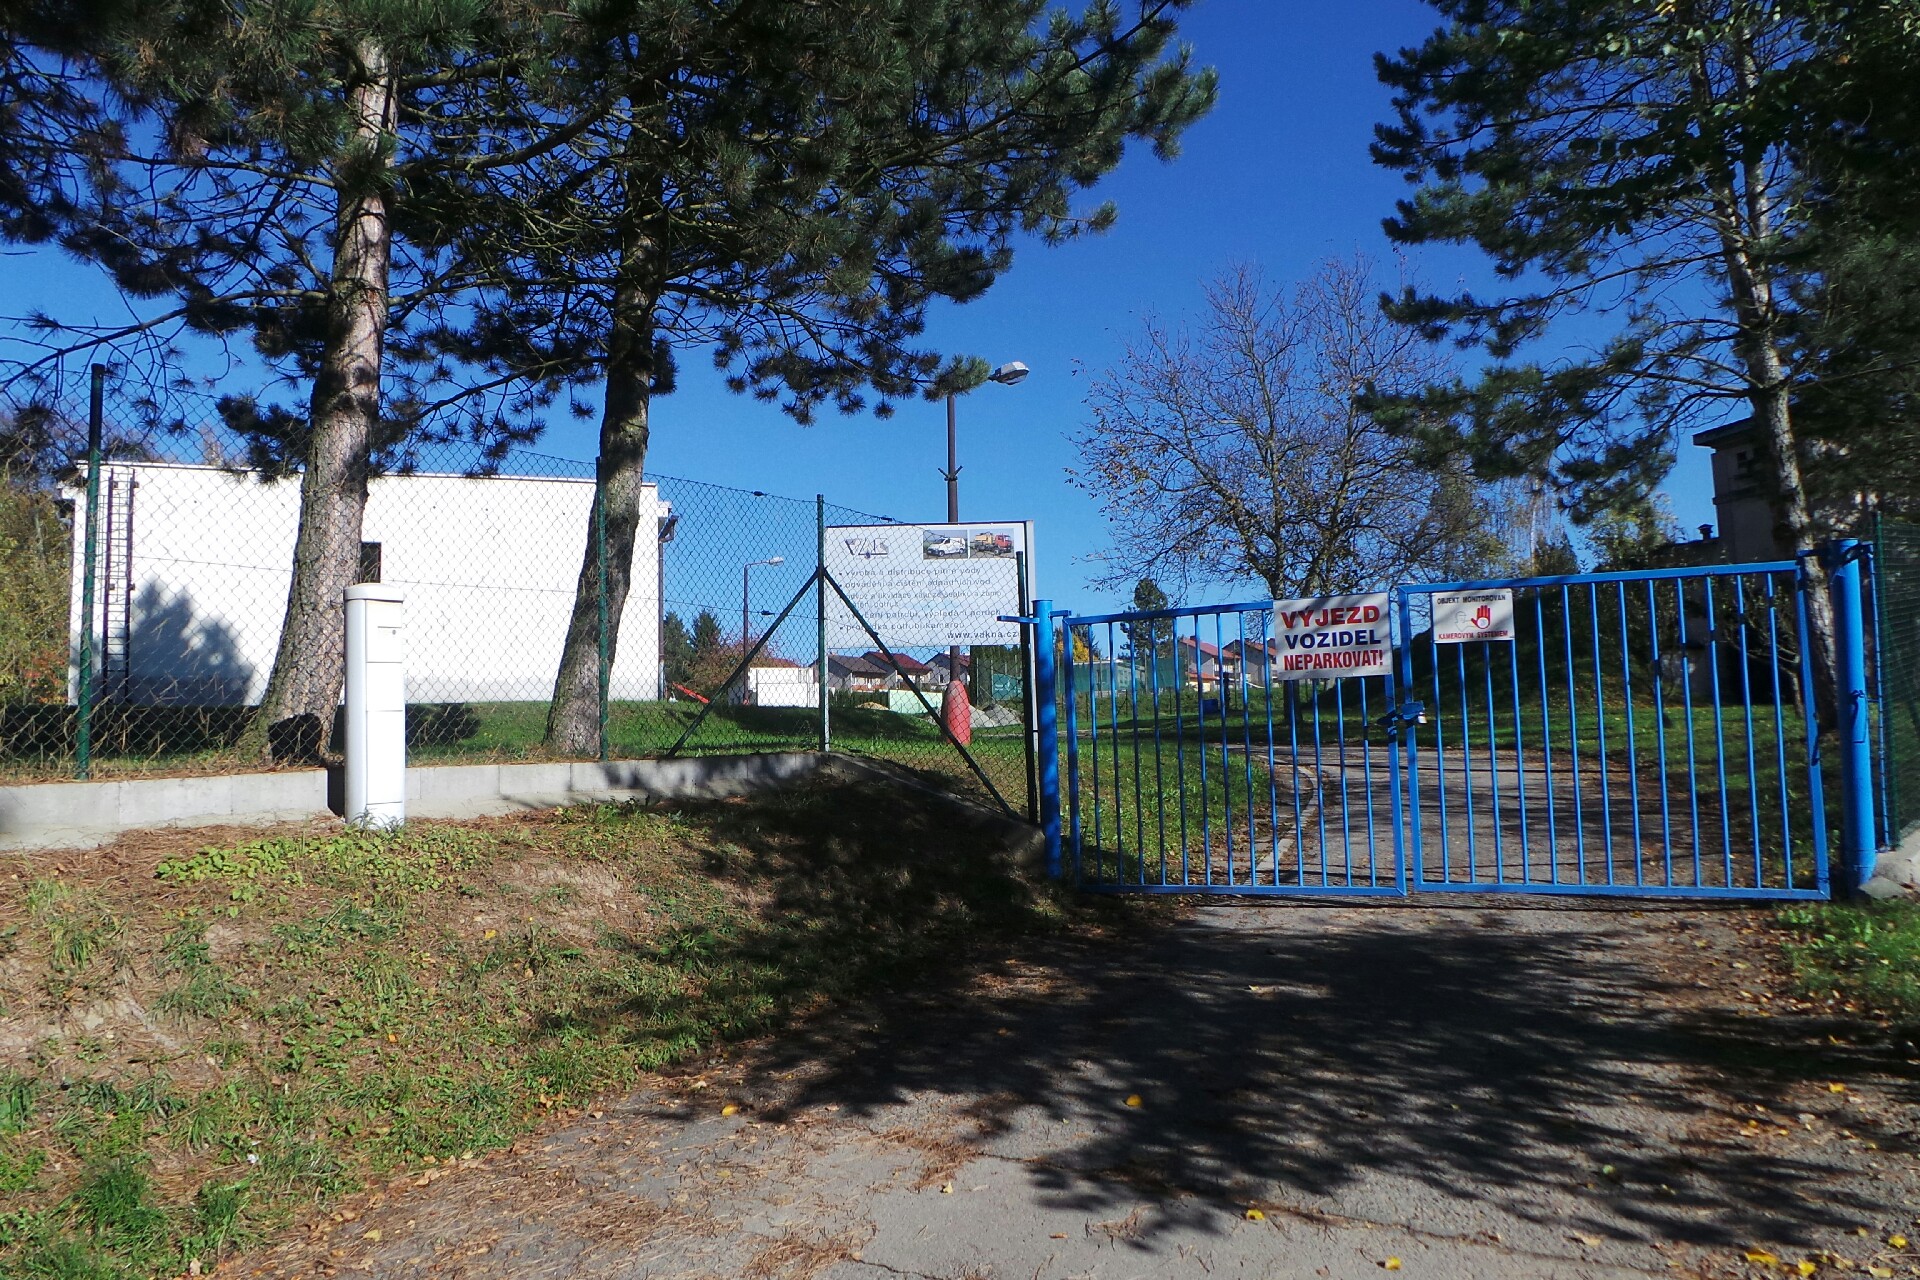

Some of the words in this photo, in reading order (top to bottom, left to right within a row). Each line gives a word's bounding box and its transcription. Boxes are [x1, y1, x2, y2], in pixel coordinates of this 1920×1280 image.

[1437, 596, 1460, 605] OBJEKT
[1280, 604, 1380, 629] VÝJEZD
[1284, 630, 1381, 650] VOZIDEL
[1283, 649, 1383, 671] NEPARKOVAT!
